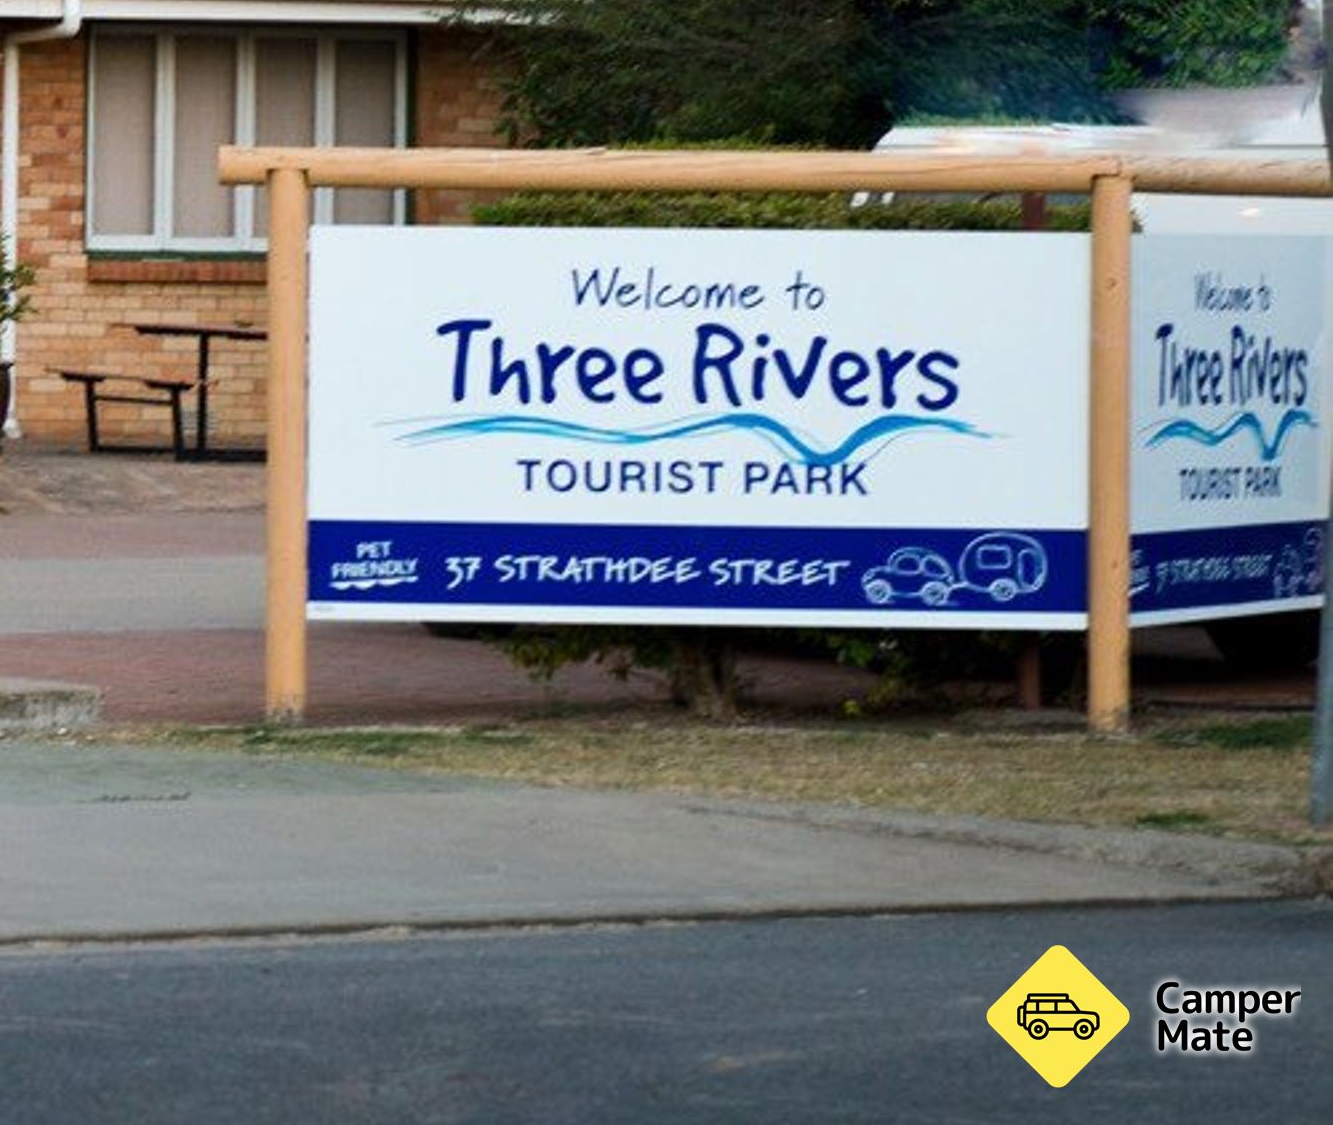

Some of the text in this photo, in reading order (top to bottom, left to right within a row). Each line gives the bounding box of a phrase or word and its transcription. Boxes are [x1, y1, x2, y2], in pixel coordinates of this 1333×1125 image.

[571, 266, 826, 311] Welcome to
[436, 319, 959, 411] Three Rivers
[1155, 323, 1308, 407] Three Rivers
[516, 459, 869, 495] TOURIST PARK
[1179, 465, 1282, 501] TOURIST PARK
[355, 540, 393, 559] PET
[331, 557, 419, 580] FRIENDLY
[444, 554, 852, 591] 37 STRATHDEE STREET
